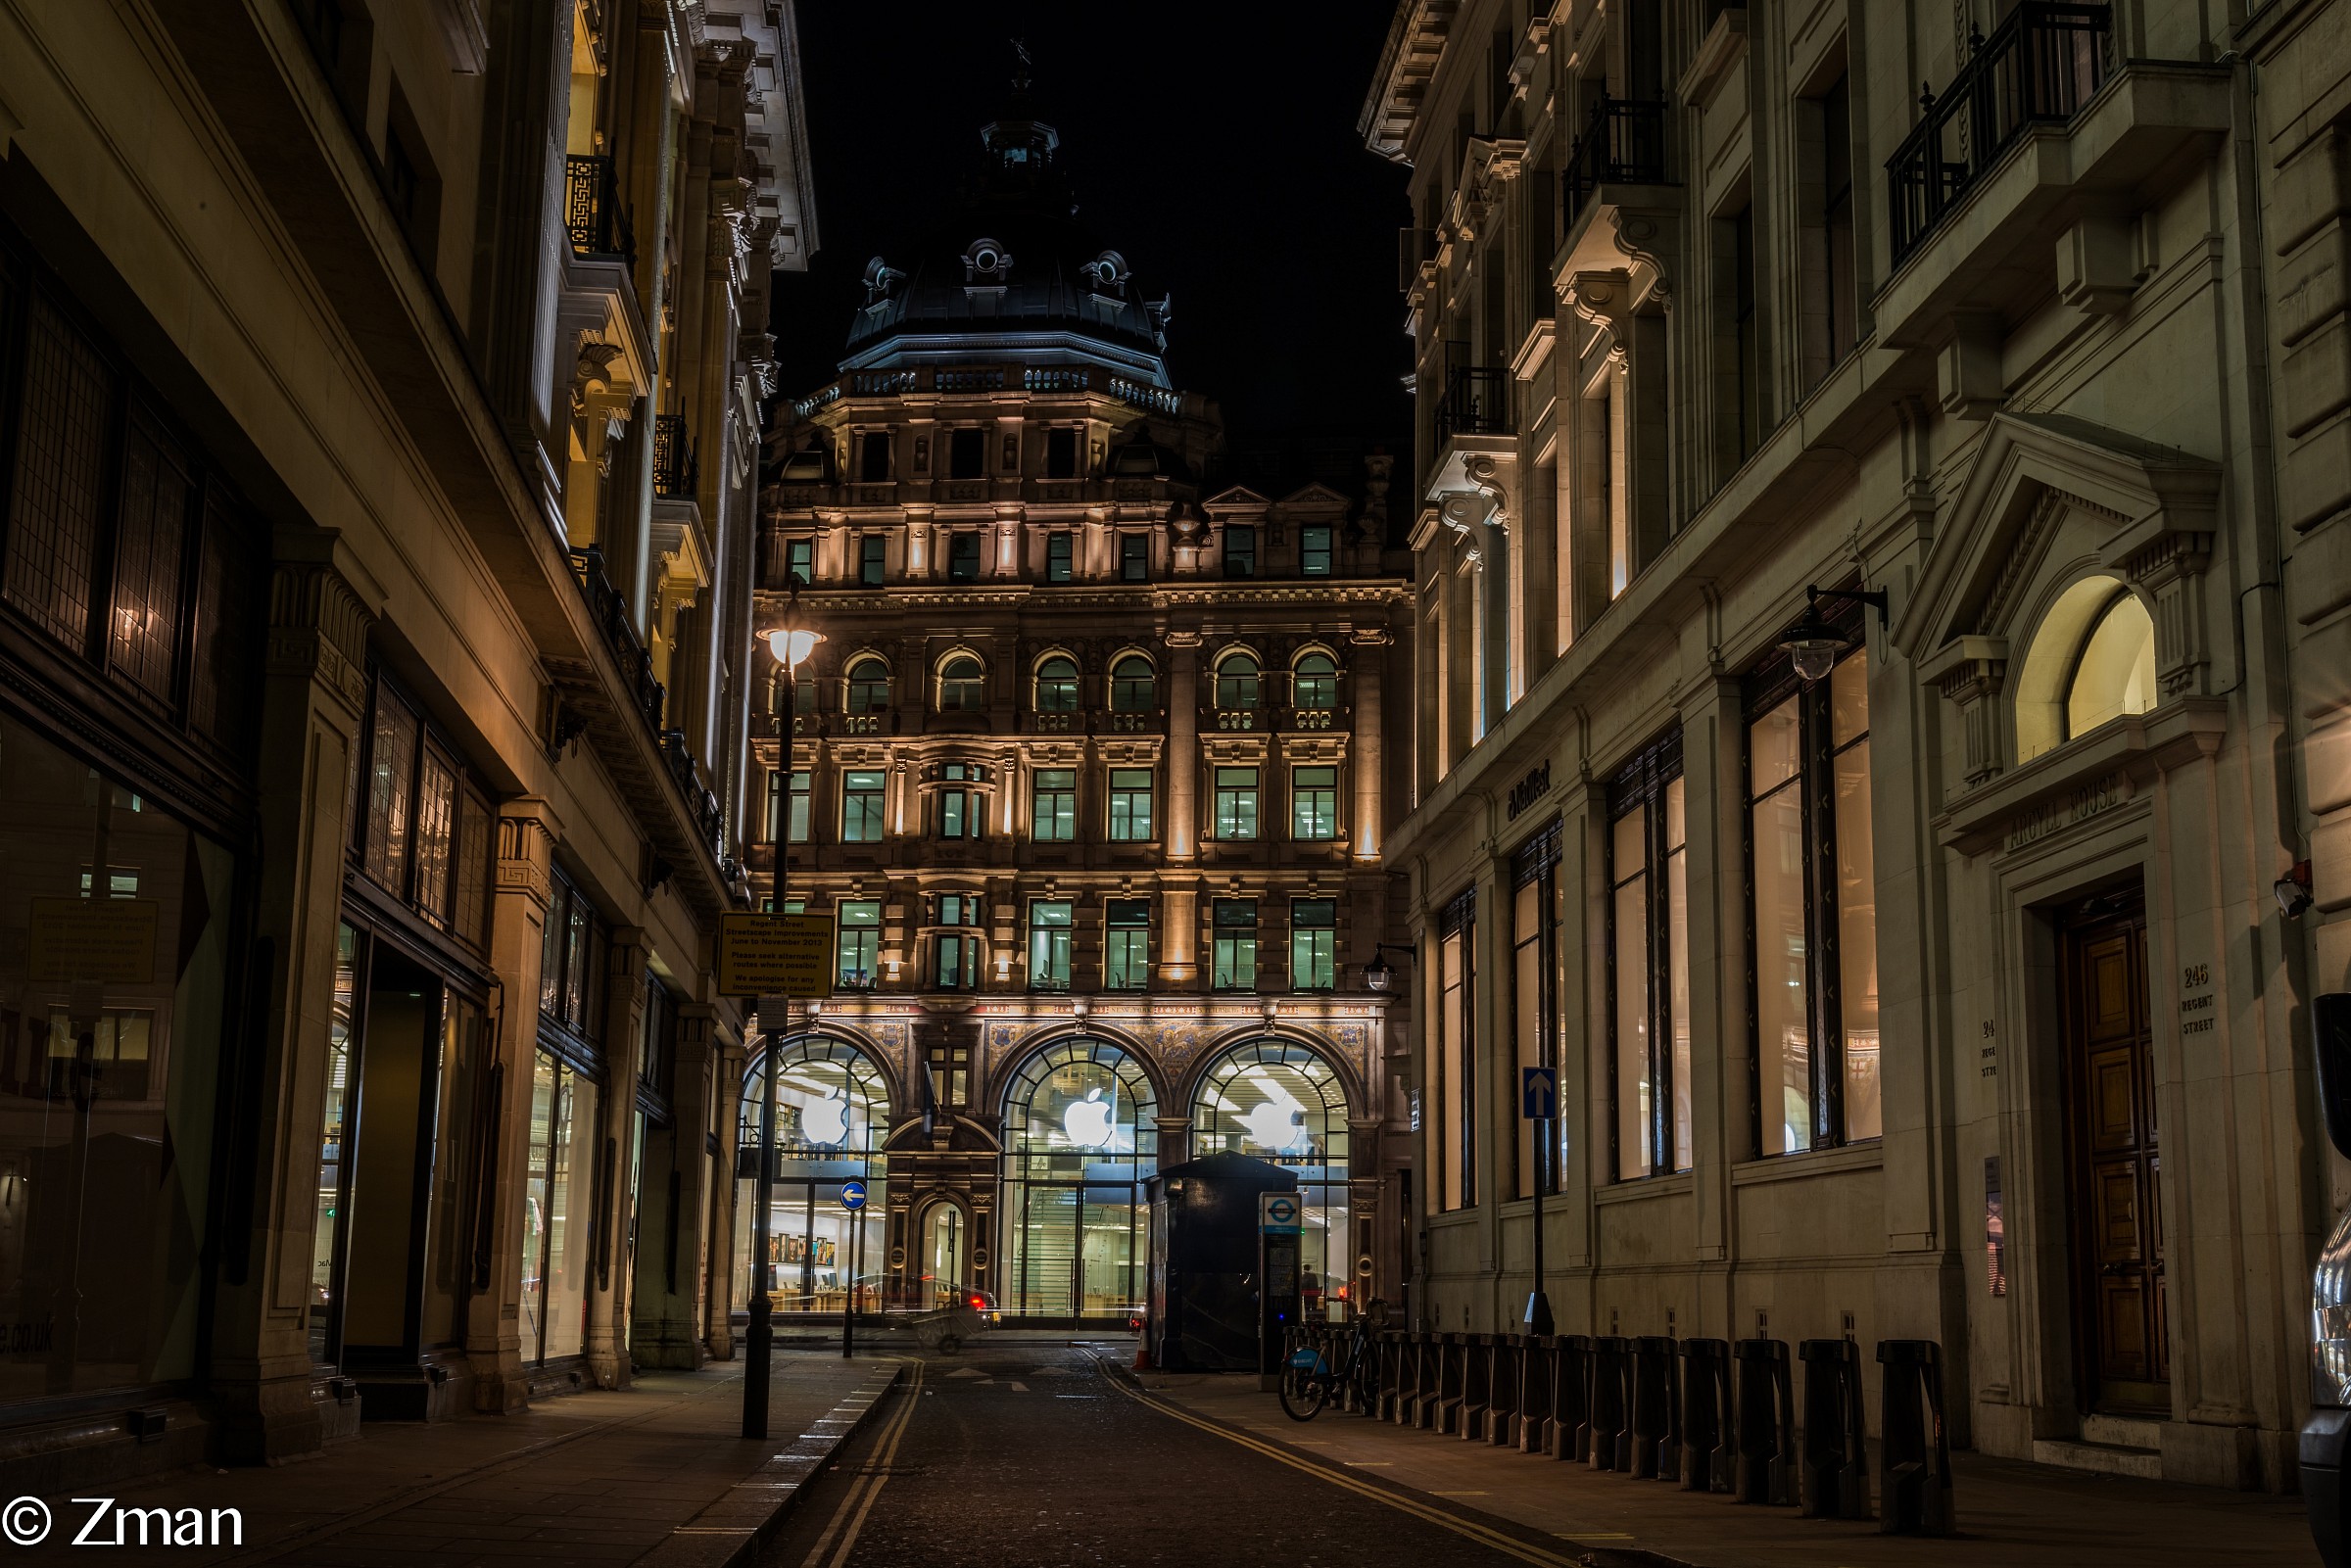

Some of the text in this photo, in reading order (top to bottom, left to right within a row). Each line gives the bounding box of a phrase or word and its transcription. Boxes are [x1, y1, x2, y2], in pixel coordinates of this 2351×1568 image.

[2010, 772, 2117, 849] ARGYLL HOUSE
[748, 974, 785, 983] apologise
[2184, 963, 2208, 988] 246
[2183, 994, 2213, 1012] REGENT
[1983, 1019, 1994, 1038] 24
[2183, 1018, 2214, 1035] STREET
